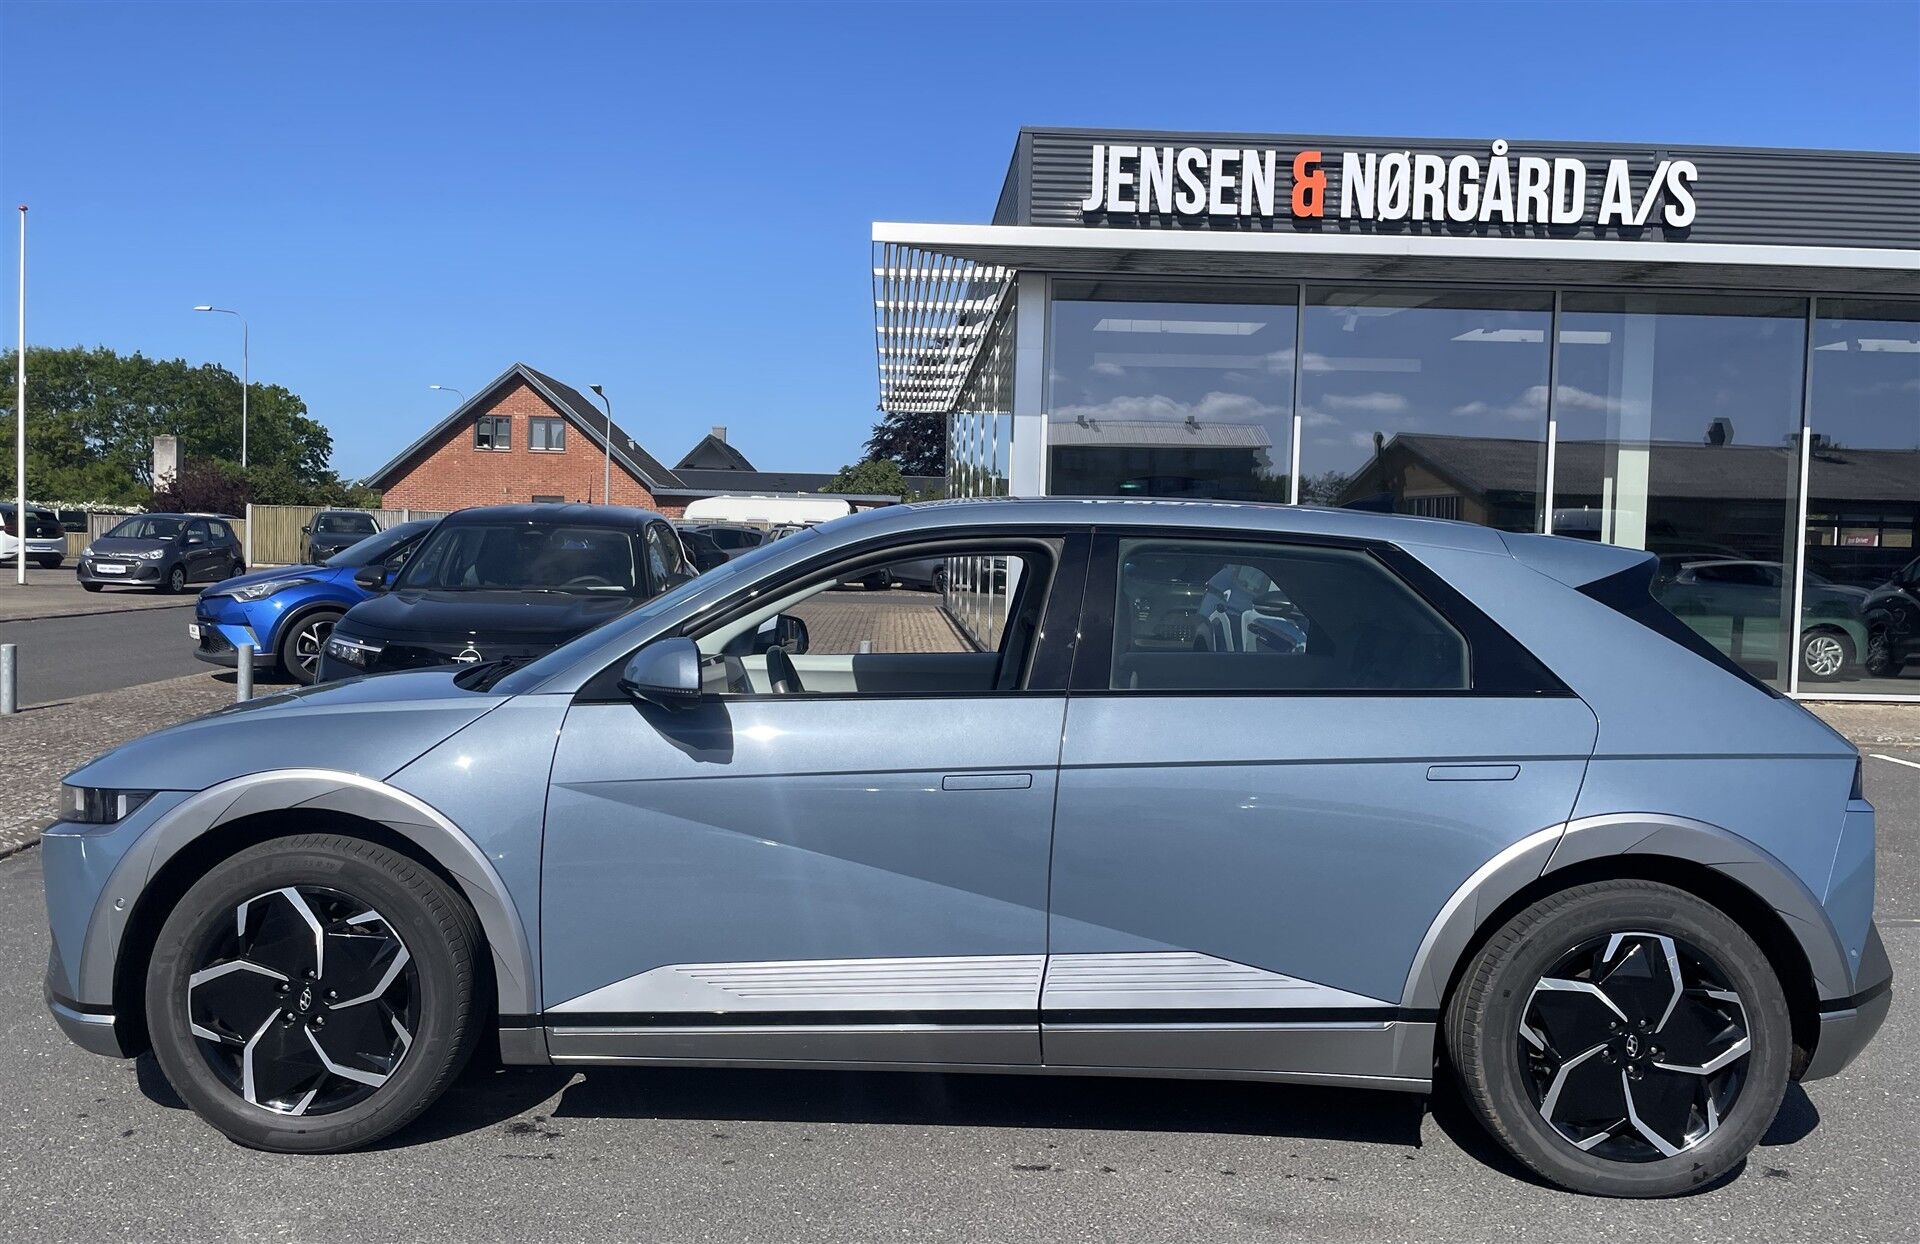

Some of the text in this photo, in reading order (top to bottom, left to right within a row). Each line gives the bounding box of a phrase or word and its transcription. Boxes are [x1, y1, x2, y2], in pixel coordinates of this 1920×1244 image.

[1082, 138, 1699, 228] JENSEN & NØRGÅRD A/S
